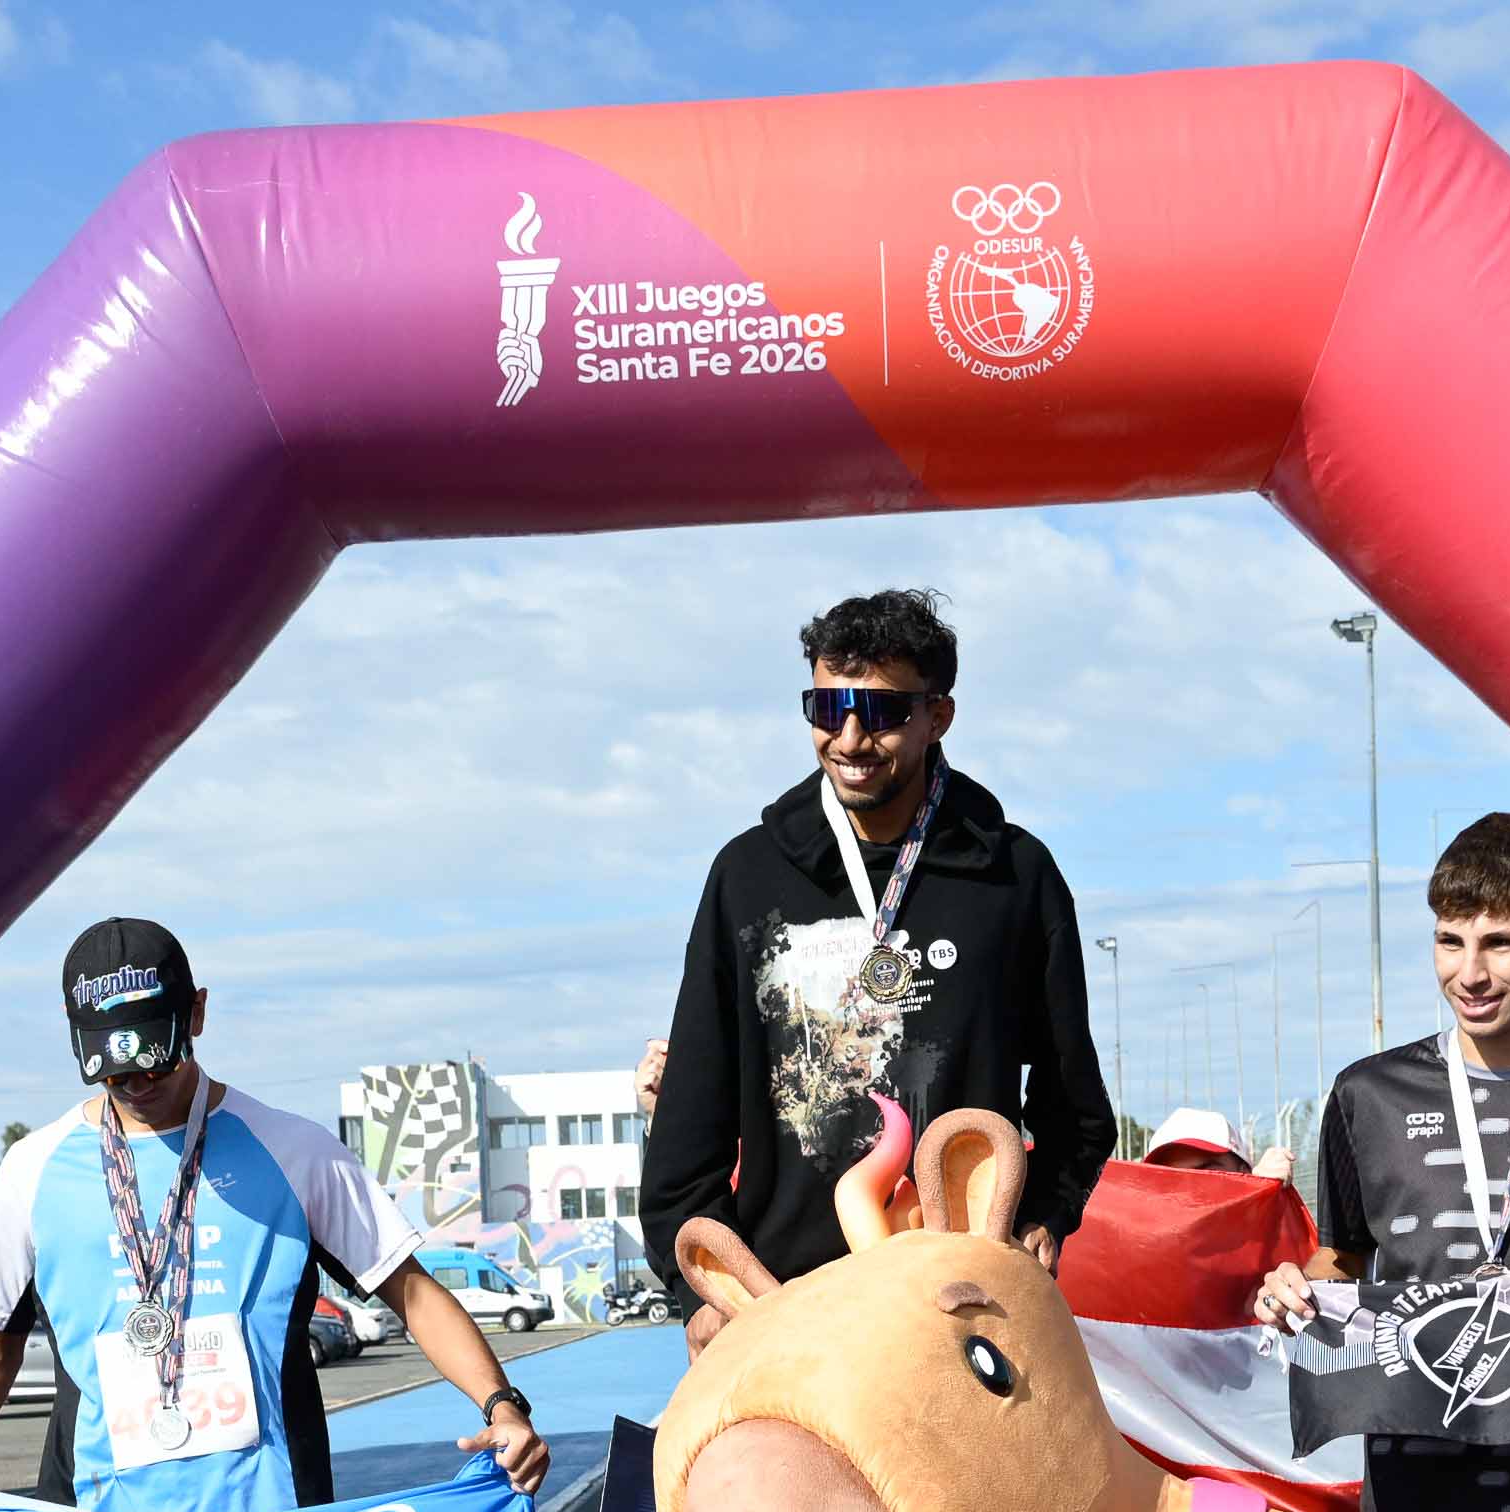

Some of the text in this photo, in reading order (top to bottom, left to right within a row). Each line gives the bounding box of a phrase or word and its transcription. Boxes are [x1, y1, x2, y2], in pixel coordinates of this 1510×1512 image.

[973, 237, 1044, 256] ODESUR
[571, 281, 766, 317] XIII Juegos
[926, 235, 1094, 382] ORGANIZACION DEPORTIVA SURAMERICANA
[574, 308, 845, 350] Suramericanos
[576, 341, 828, 383] Santa Fe 2026
[931, 947, 955, 960] TBS
[72, 964, 158, 1011] Argentina
[1407, 1124, 1443, 1139] graph
[1392, 1281, 1464, 1314] TEAM
[1446, 1321, 1486, 1367] MARCELO
[1460, 1353, 1497, 1392] MENDEZ
